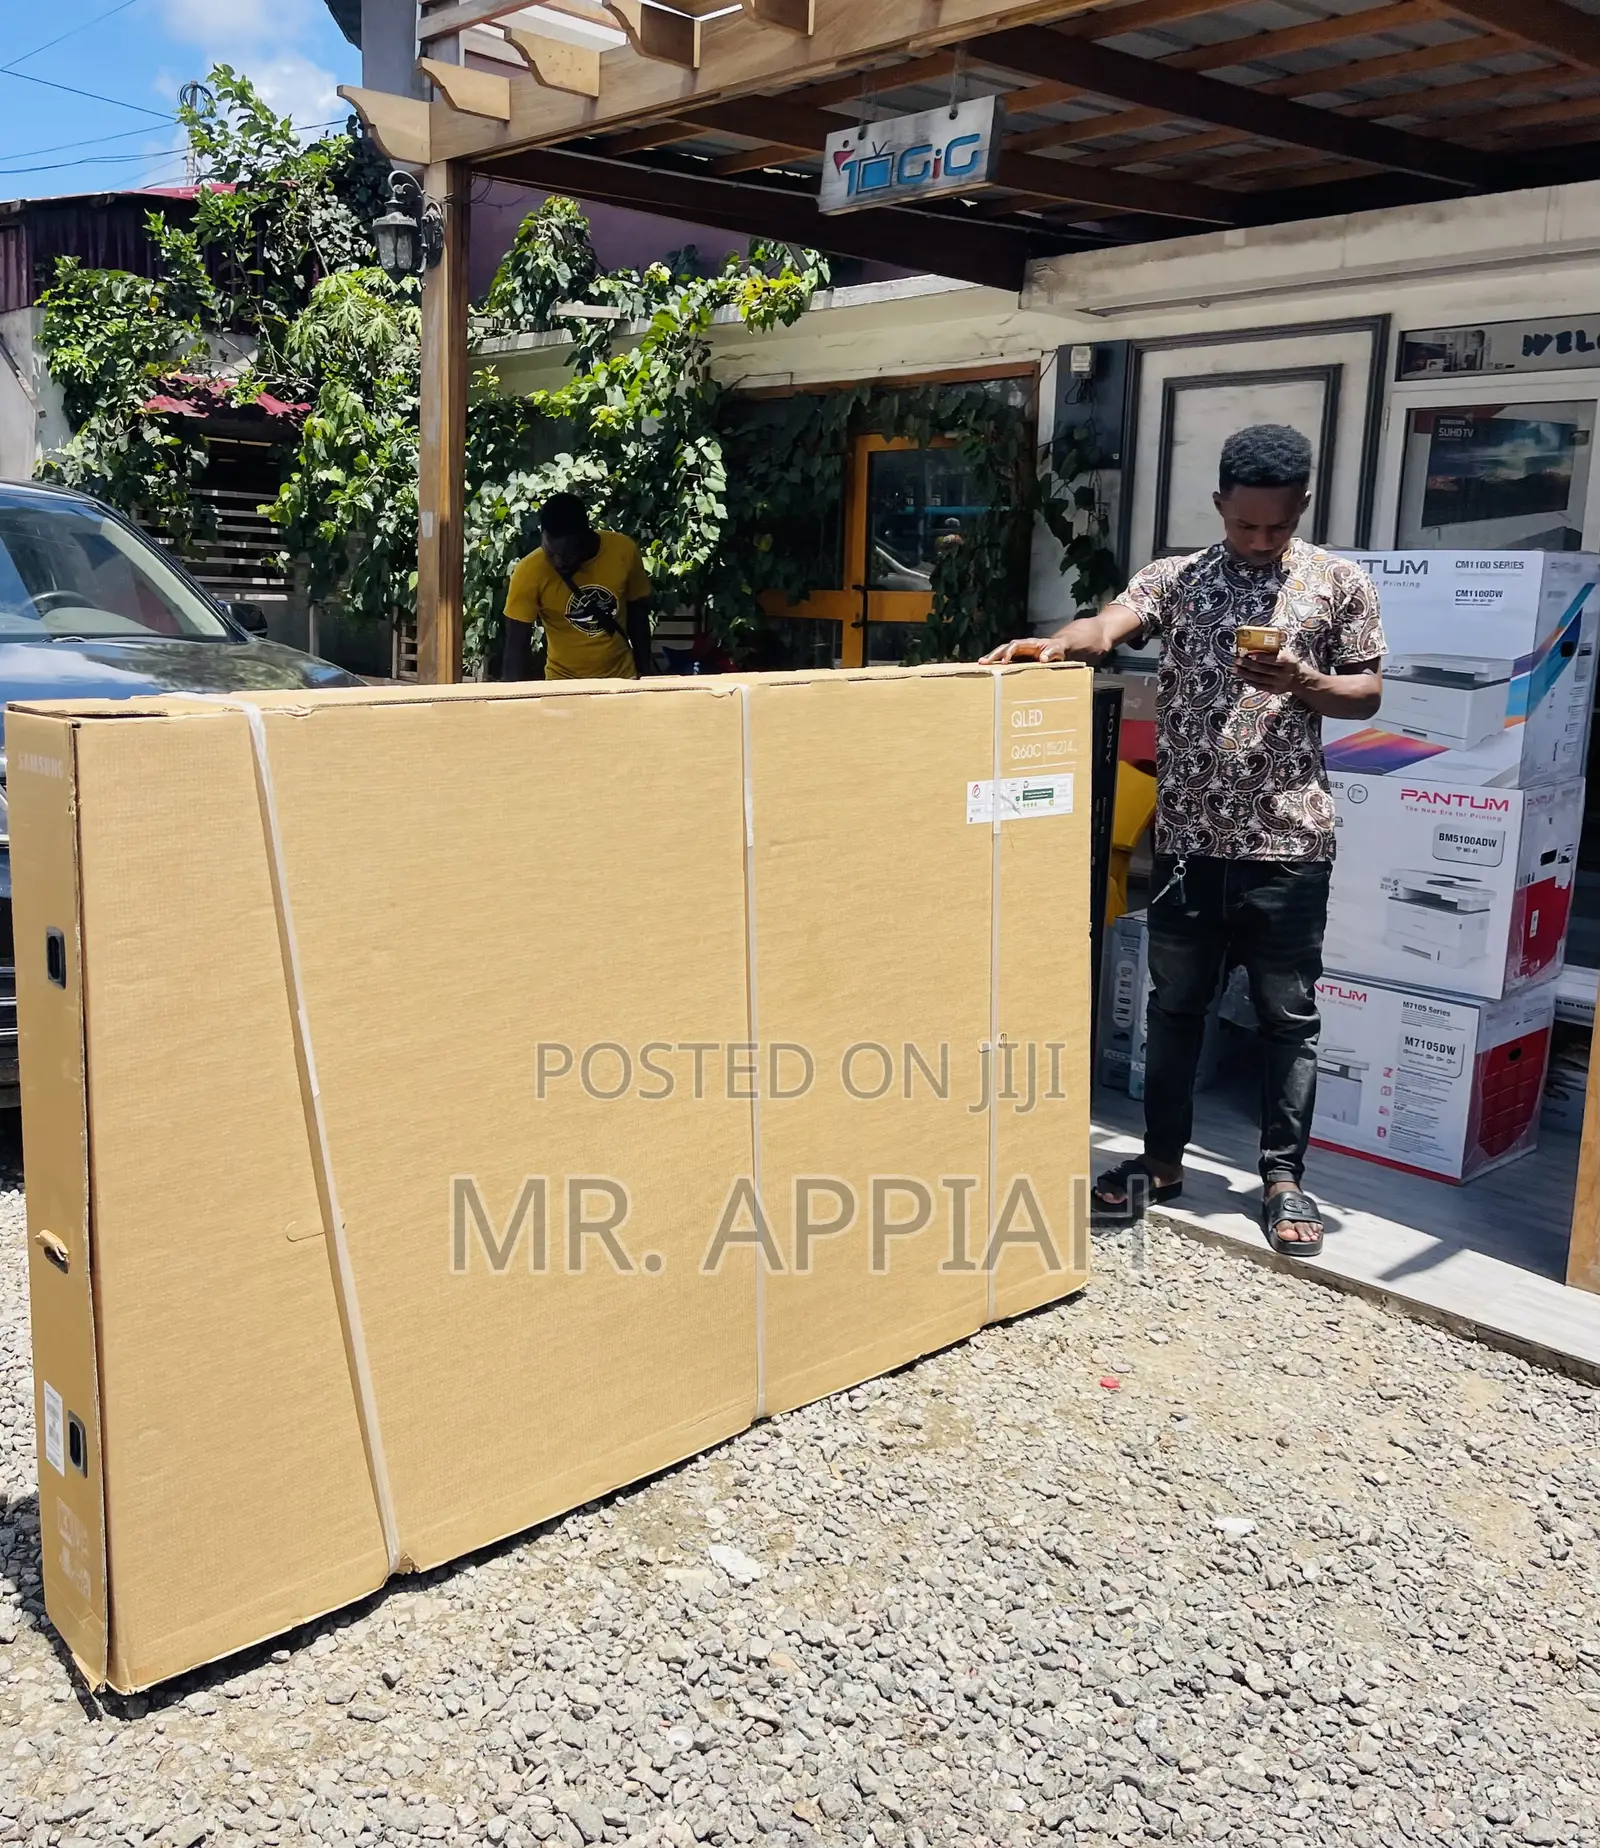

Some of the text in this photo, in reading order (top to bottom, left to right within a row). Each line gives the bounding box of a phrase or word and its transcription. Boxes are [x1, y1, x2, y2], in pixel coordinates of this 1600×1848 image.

[1522, 329, 1600, 357] WEL
[1356, 559, 1429, 575] TUM
[1455, 560, 1524, 569] CM1100 SERIES
[1383, 580, 1421, 588] Printing
[1455, 589, 1503, 598] CM1100DW
[1011, 709, 1043, 728] QLED
[1105, 703, 1115, 766] SONY
[1011, 743, 1042, 760] Q60C
[1401, 788, 1509, 812] PANTUM
[1470, 813, 1502, 822] Printing
[1439, 832, 1497, 848] BM5100ADW
[1313, 983, 1367, 1002] NTUM
[1402, 1000, 1451, 1017] M7105 Series
[1405, 1036, 1456, 1055] M7105DW
